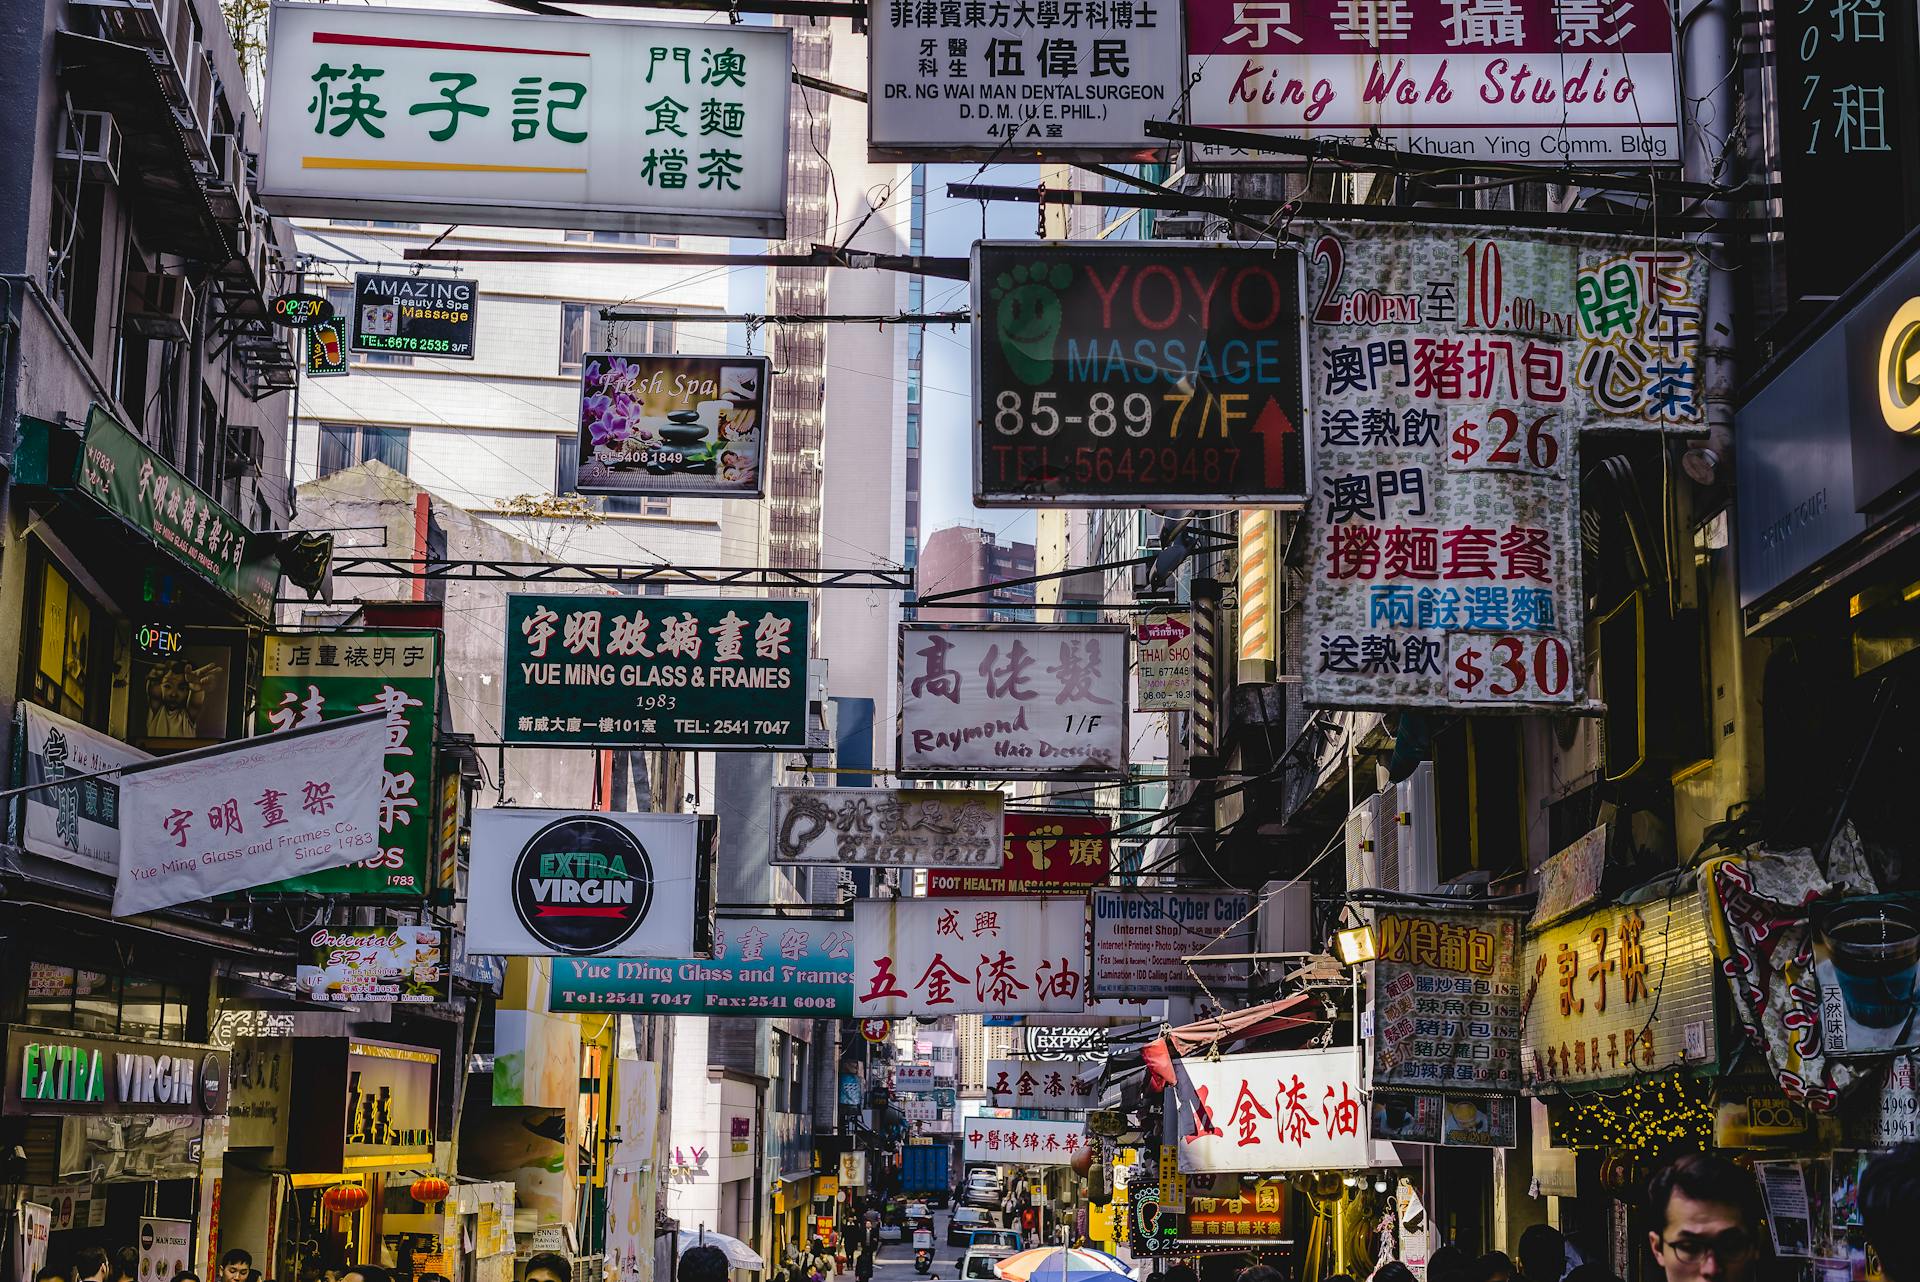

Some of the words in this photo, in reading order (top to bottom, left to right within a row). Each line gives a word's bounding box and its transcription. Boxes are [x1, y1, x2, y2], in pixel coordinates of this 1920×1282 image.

[891, 1, 1158, 29] 菲律賓東方大學牙科博士
[984, 37, 1131, 79] 伍偉民
[885, 84, 912, 99] DR.
[915, 84, 939, 99] NG
[943, 84, 976, 99] WAI
[980, 84, 1017, 100] MAN
[1021, 84, 1085, 100] DENTAL
[1085, 84, 1164, 100] SURGEON
[1228, 58, 1334, 121] King
[1362, 58, 1452, 105] Wah
[1480, 58, 1636, 105] Studio
[307, 63, 589, 144] 筷子記
[1408, 135, 1479, 154] Khuan
[1485, 136, 1532, 160] Ying
[1540, 136, 1612, 154] Comm.
[1621, 136, 1667, 158] Bldg
[363, 278, 470, 300] AMAZING
[1084, 264, 1281, 331] YOYO
[1426, 281, 1456, 322] 至
[276, 299, 323, 316] OPEN
[392, 297, 433, 309] Beauty
[435, 300, 444, 308] &
[446, 300, 469, 310] Spa
[402, 307, 469, 323] Massage
[291, 315, 307, 324] 3/F
[419, 339, 449, 351] 2535
[451, 343, 468, 352] 3/F
[1068, 338, 1281, 384] MASSAGE
[599, 370, 665, 397] Fresh
[668, 373, 714, 403] Spa
[994, 390, 1152, 438] 85-89
[1162, 392, 1250, 439] 7/F
[1320, 407, 1441, 448] 送熱飲
[1451, 408, 1560, 468] $26
[651, 453, 683, 463] 1849
[1323, 467, 1426, 524] 澳門
[1326, 524, 1553, 583] 撈麵套餐
[1370, 584, 1556, 631] 兩餸選麵
[139, 628, 177, 653] OPEN
[521, 605, 793, 663] 宇明玻璃畫架
[1140, 649, 1163, 662] THAI
[1319, 634, 1441, 675] 送熱飲
[1453, 637, 1569, 696] $30
[521, 662, 561, 685] YUE
[565, 663, 615, 686] MING
[619, 664, 687, 687] GLASS
[691, 666, 705, 687] &
[709, 666, 791, 689] FRAMES
[910, 634, 1114, 705] 高佬髮
[1140, 667, 1155, 677] TEL
[636, 693, 677, 711] 1983
[674, 719, 710, 734] TEL:
[713, 720, 749, 735] 2541
[754, 720, 791, 735] 7047
[912, 705, 1028, 754] Raymond
[1064, 714, 1103, 736] 1/F
[994, 739, 1033, 758] Hair
[1038, 739, 1113, 761] Dressing
[163, 780, 336, 848] 宇明畫架
[131, 865, 158, 882] Yue
[162, 857, 197, 875] Ming
[202, 847, 243, 865] Glass
[247, 838, 274, 856] and
[279, 828, 331, 849] Frames
[334, 822, 358, 834] Co.
[295, 844, 332, 861] Since
[337, 832, 373, 848] 1983
[540, 853, 629, 879] EXTRA
[386, 874, 415, 886] 1983
[529, 879, 633, 904] VIRGIN
[932, 876, 961, 890] FOOT
[963, 877, 1006, 892] HEALTH
[1097, 896, 1163, 920] Universal
[1168, 897, 1211, 923] Cyber
[1214, 897, 1247, 920] Café
[936, 907, 1001, 940] 成興
[1113, 924, 1152, 935] (Internet
[1155, 925, 1182, 937] Shop)
[311, 929, 397, 947] Oriental
[1100, 941, 1124, 950] Internet
[1128, 942, 1151, 952] Printing
[1155, 942, 1171, 950] Photo
[1173, 942, 1187, 952] Copy
[1378, 913, 1496, 976] 必食葡包
[327, 950, 378, 966] SPA
[1100, 955, 1111, 964] Fax
[571, 959, 611, 980] Yue
[617, 961, 673, 984] Ming
[678, 964, 732, 982] Glass
[739, 964, 774, 983] and
[781, 965, 855, 984] Frames
[859, 950, 1080, 1006] 五金漆油
[1100, 970, 1132, 979] Lamination
[1136, 970, 1147, 979] IDD
[650, 993, 692, 1006] 7047
[793, 995, 836, 1009] 6008
[1415, 1020, 1491, 1037] 豬扒包
[1824, 986, 1846, 1050] 天然味道
[20, 1043, 105, 1102] EXTRA
[115, 1051, 195, 1106] VIRGIN
[1191, 1219, 1282, 1236] 雲南過橋米線
